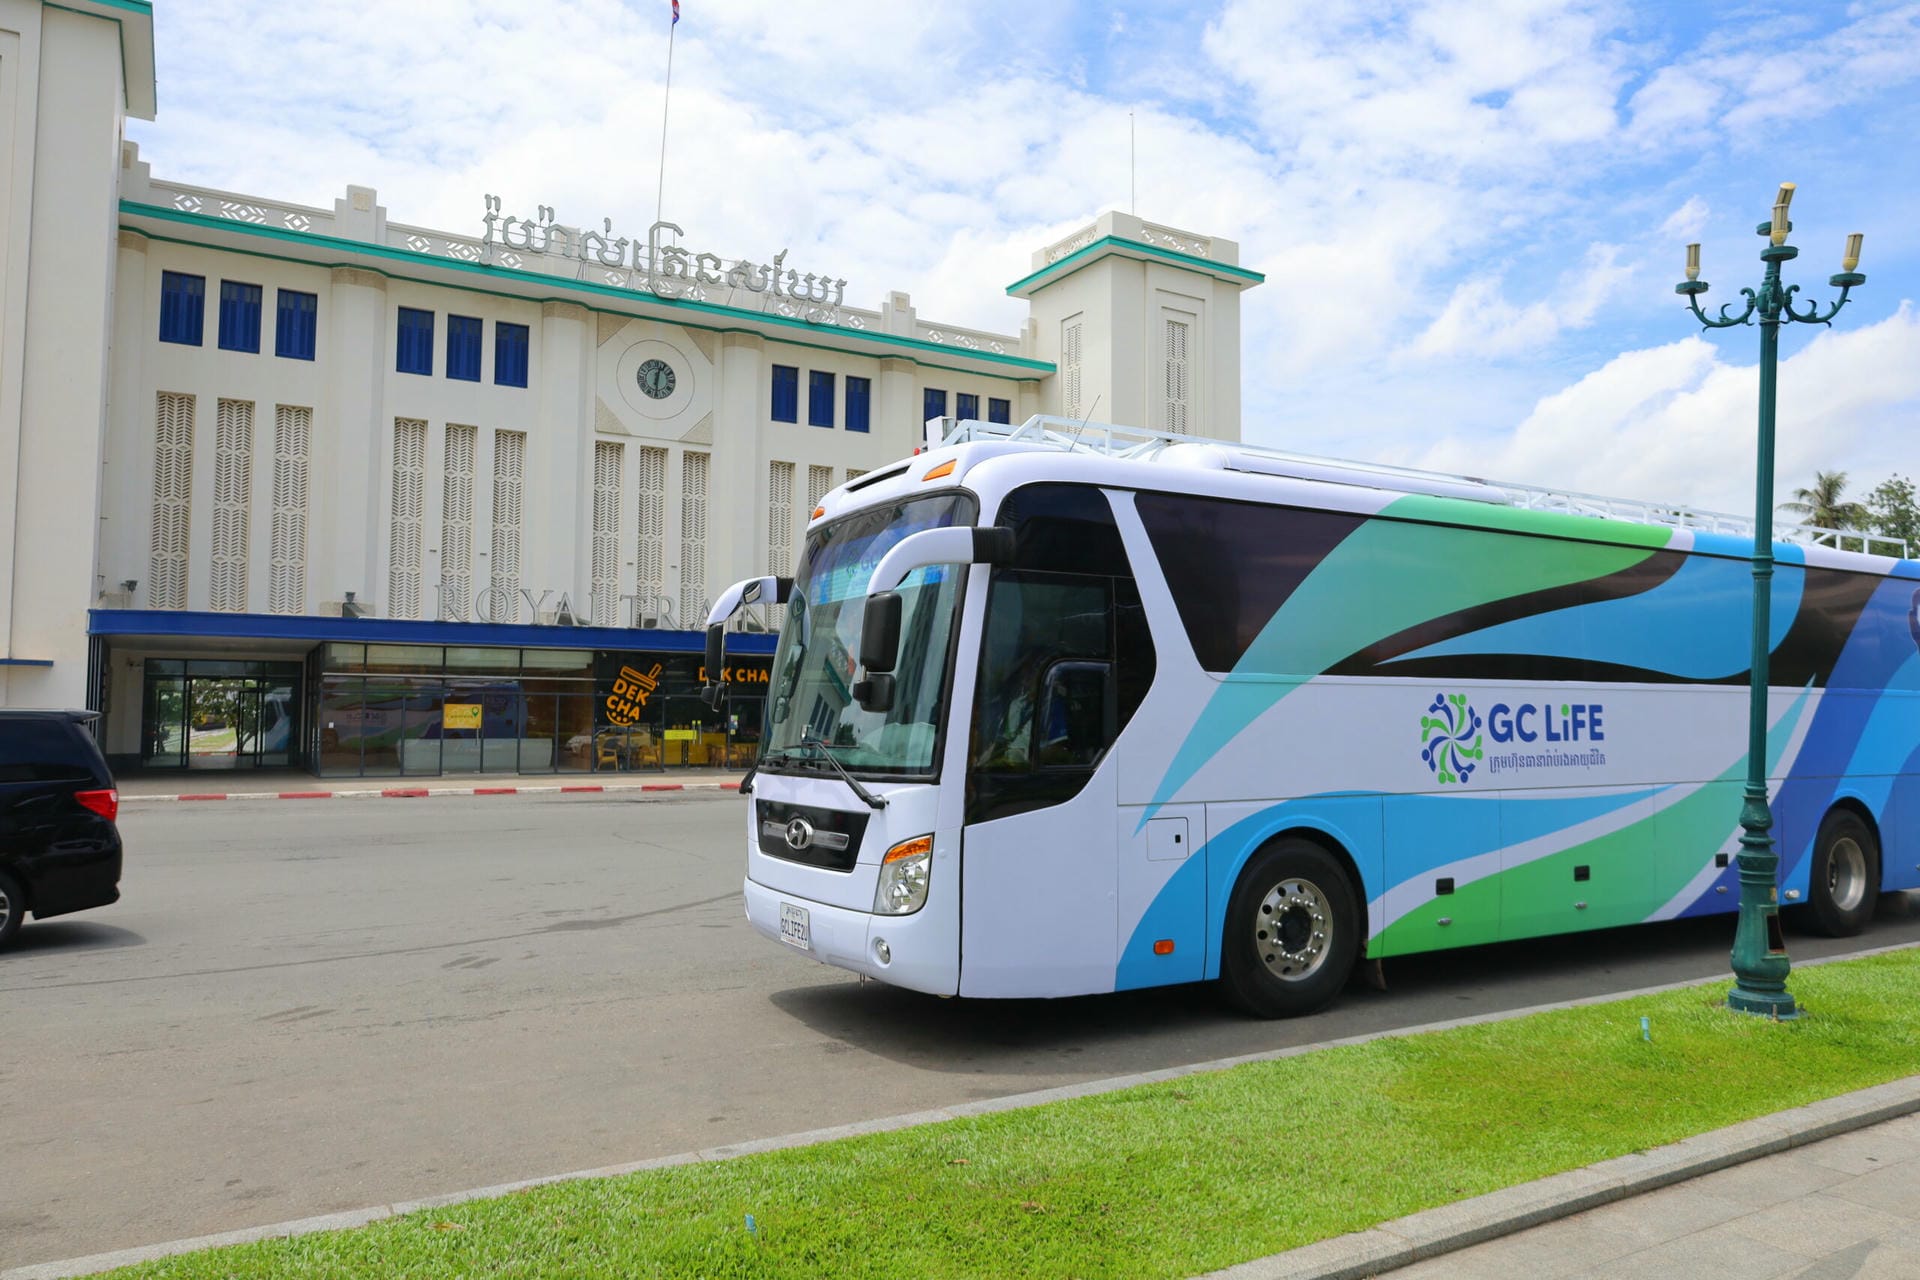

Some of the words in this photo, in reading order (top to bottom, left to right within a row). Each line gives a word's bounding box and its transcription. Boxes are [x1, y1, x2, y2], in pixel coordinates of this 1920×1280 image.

[736, 668, 769, 683] CHA
[613, 678, 650, 706] DEK
[607, 695, 640, 720] CHA
[1488, 703, 1538, 743] GC
